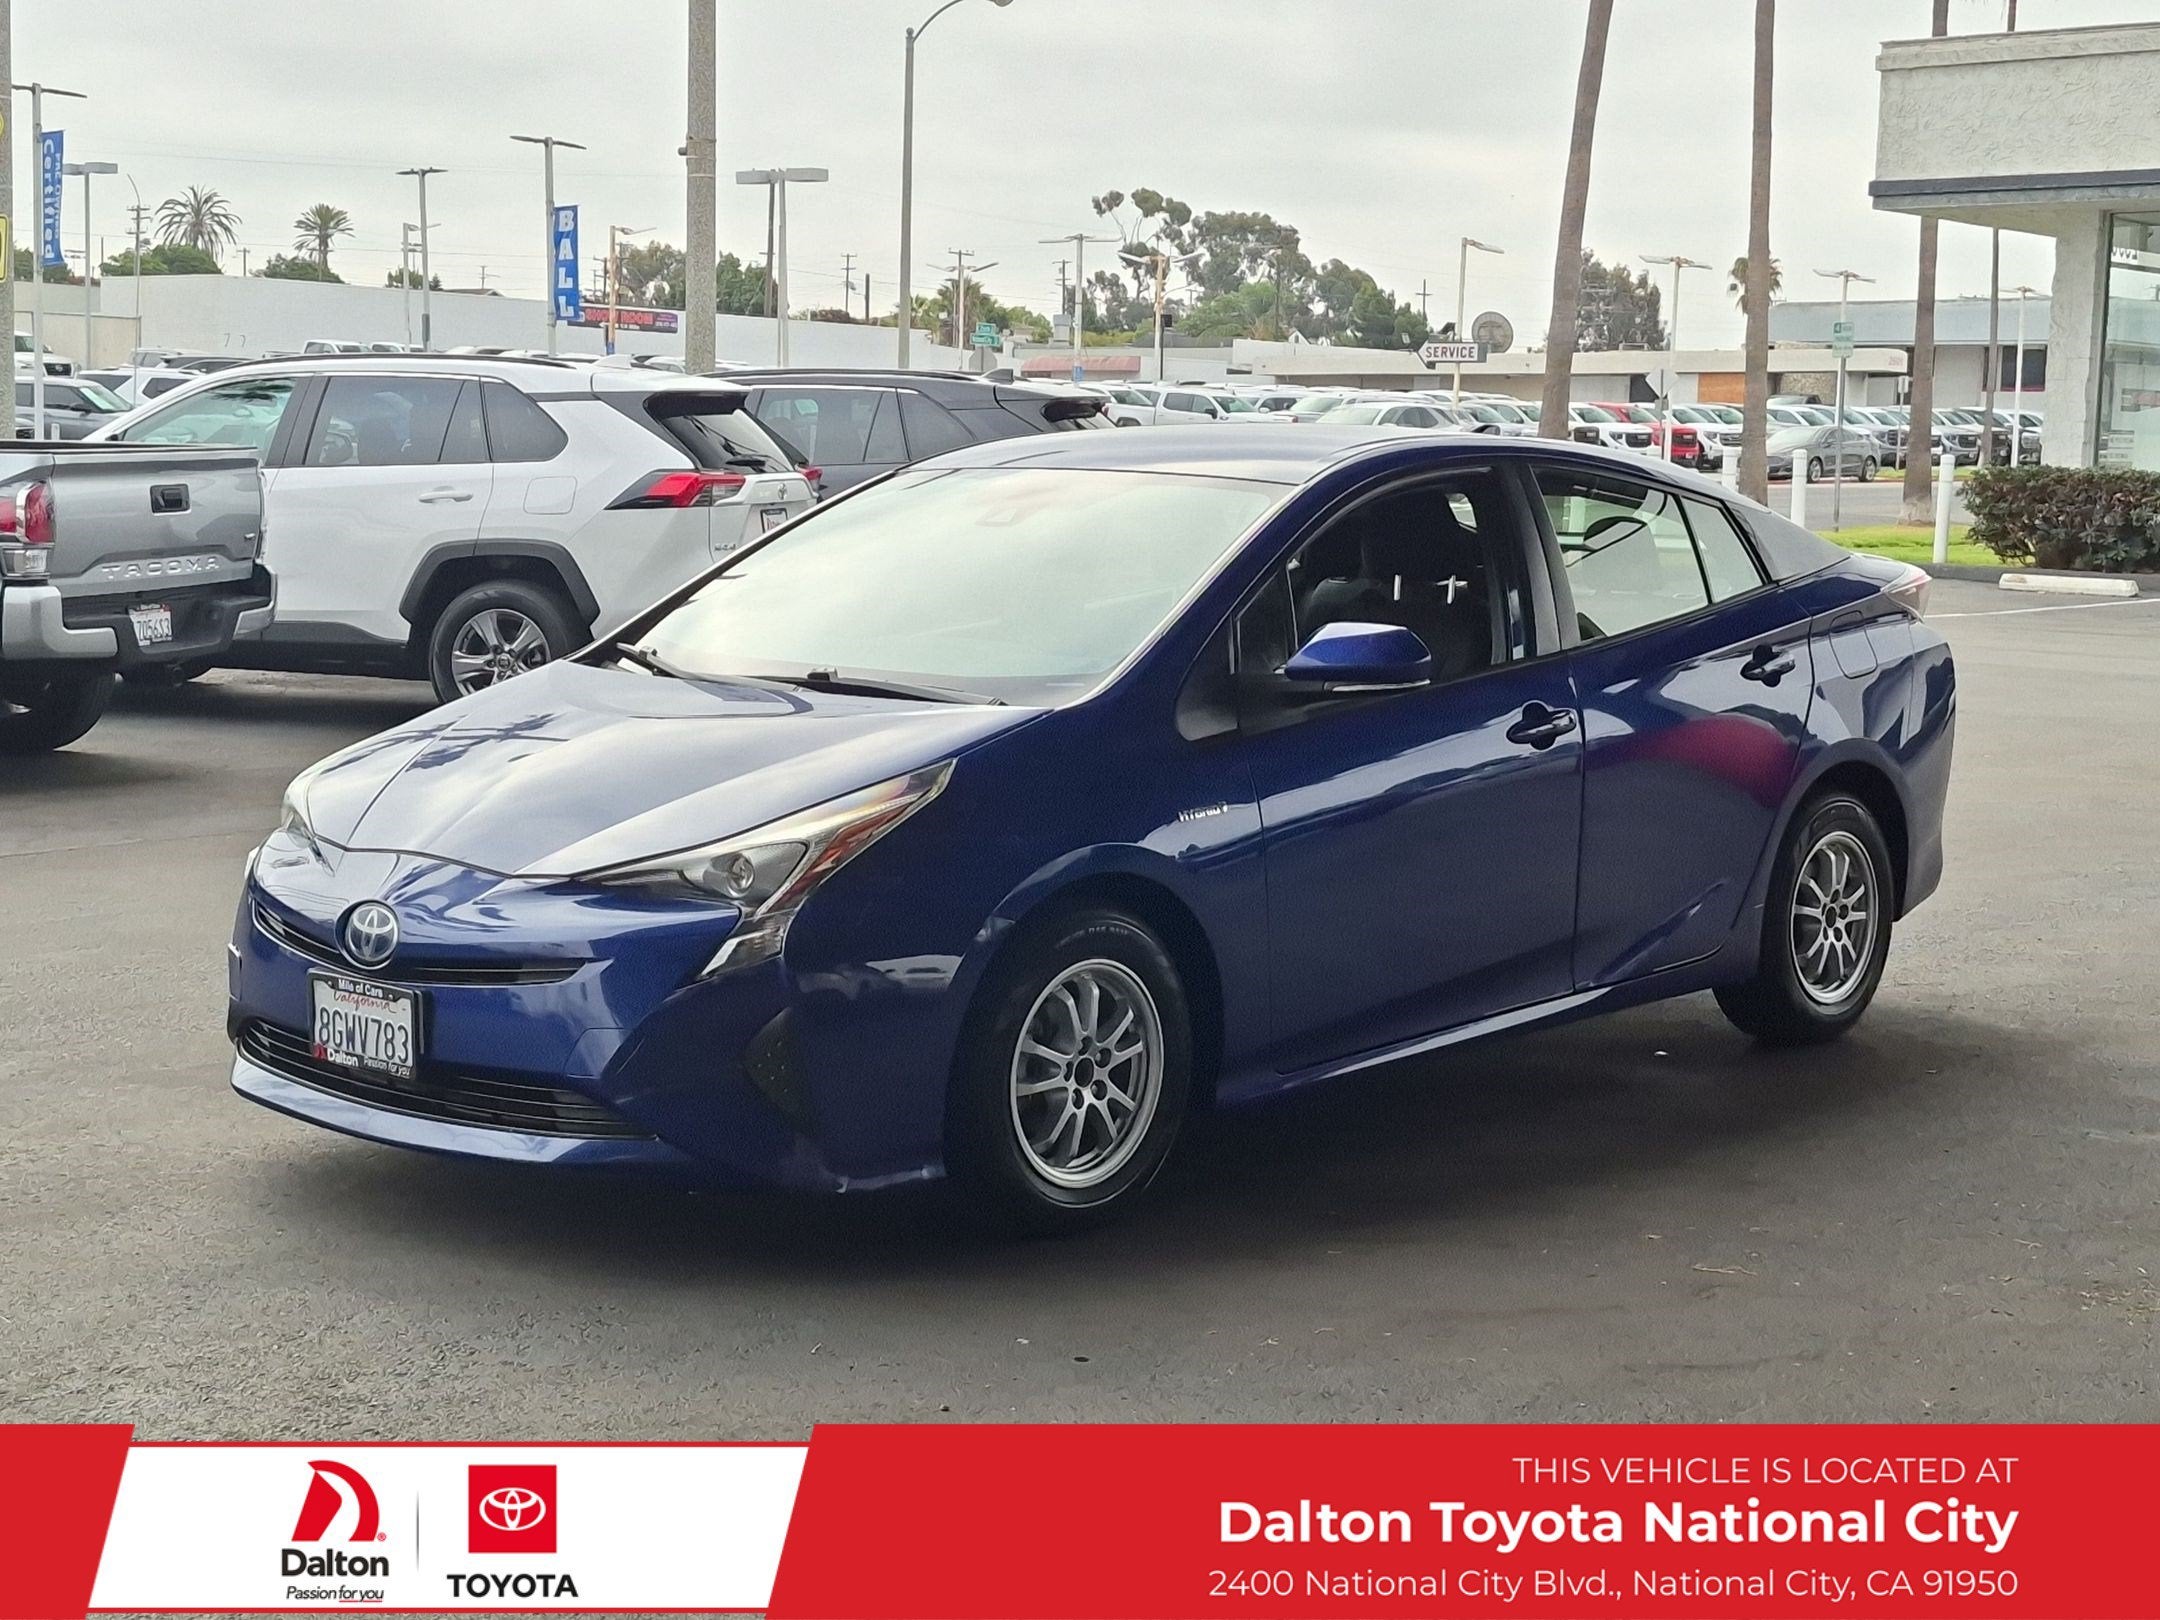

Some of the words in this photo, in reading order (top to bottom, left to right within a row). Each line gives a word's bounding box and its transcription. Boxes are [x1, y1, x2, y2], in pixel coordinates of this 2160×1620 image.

[43, 138, 56, 259] Certified
[1425, 346, 1475, 358] SERVICE
[101, 556, 220, 579] TACOMA
[338, 979, 354, 992] Mile
[355, 984, 365, 993] of
[364, 985, 383, 998] Cars
[319, 1006, 409, 1065] 8GWV783
[327, 1047, 359, 1067] Dalton
